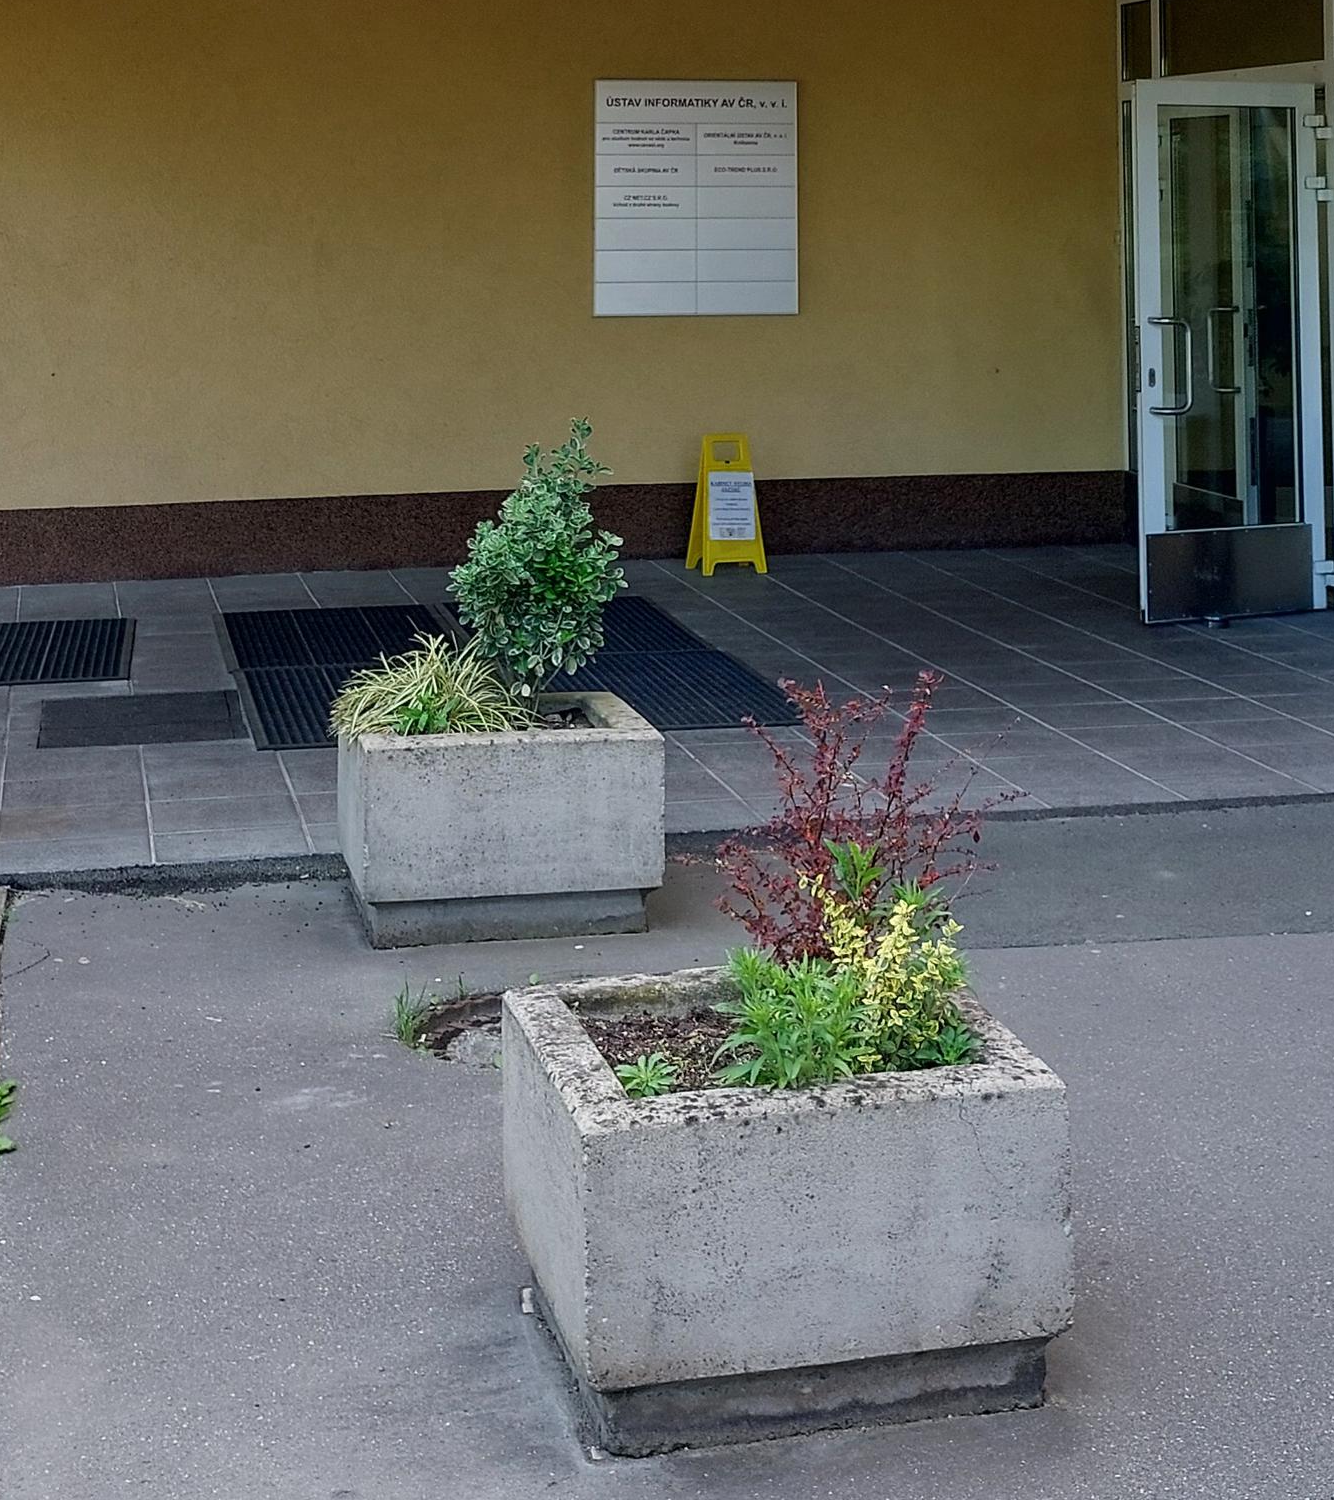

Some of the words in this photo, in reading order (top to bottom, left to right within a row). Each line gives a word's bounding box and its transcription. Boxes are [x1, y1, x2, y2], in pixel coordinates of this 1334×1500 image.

[606, 96, 642, 108] ÚSTAV
[644, 98, 719, 109] INFORMATIKY
[721, 99, 736, 109] AV
